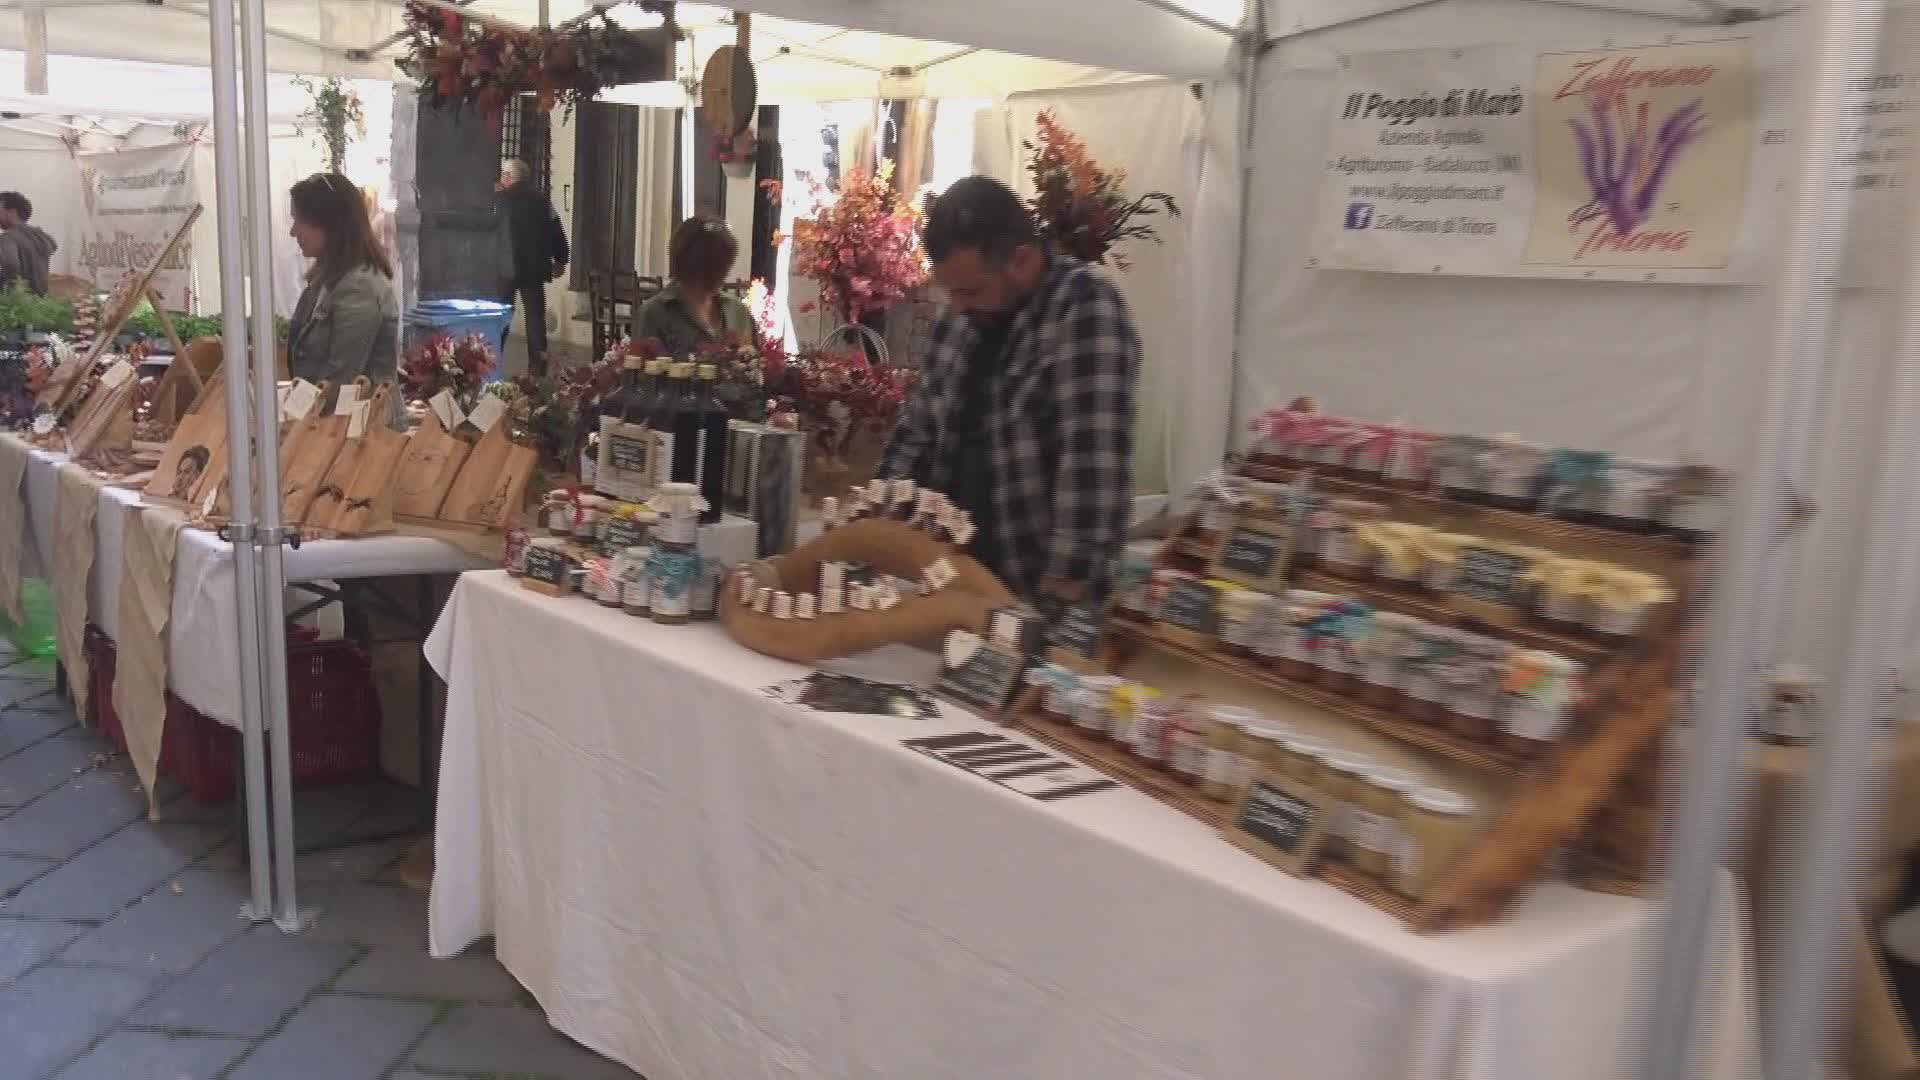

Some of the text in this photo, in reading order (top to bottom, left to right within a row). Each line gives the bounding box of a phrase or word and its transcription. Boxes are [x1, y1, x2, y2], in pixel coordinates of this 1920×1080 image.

[1553, 56, 1720, 108] Zafferano
[1342, 85, 1523, 125] Il Poggio di Marò
[1378, 128, 1485, 149] Azienda Agricola
[1337, 156, 1412, 175] Agriturismo
[1423, 155, 1492, 174] Badalucco
[1374, 214, 1440, 233] Zafferano
[1441, 215, 1457, 234] di
[1456, 217, 1497, 235] Triora
[1568, 218, 1692, 262] Triora
